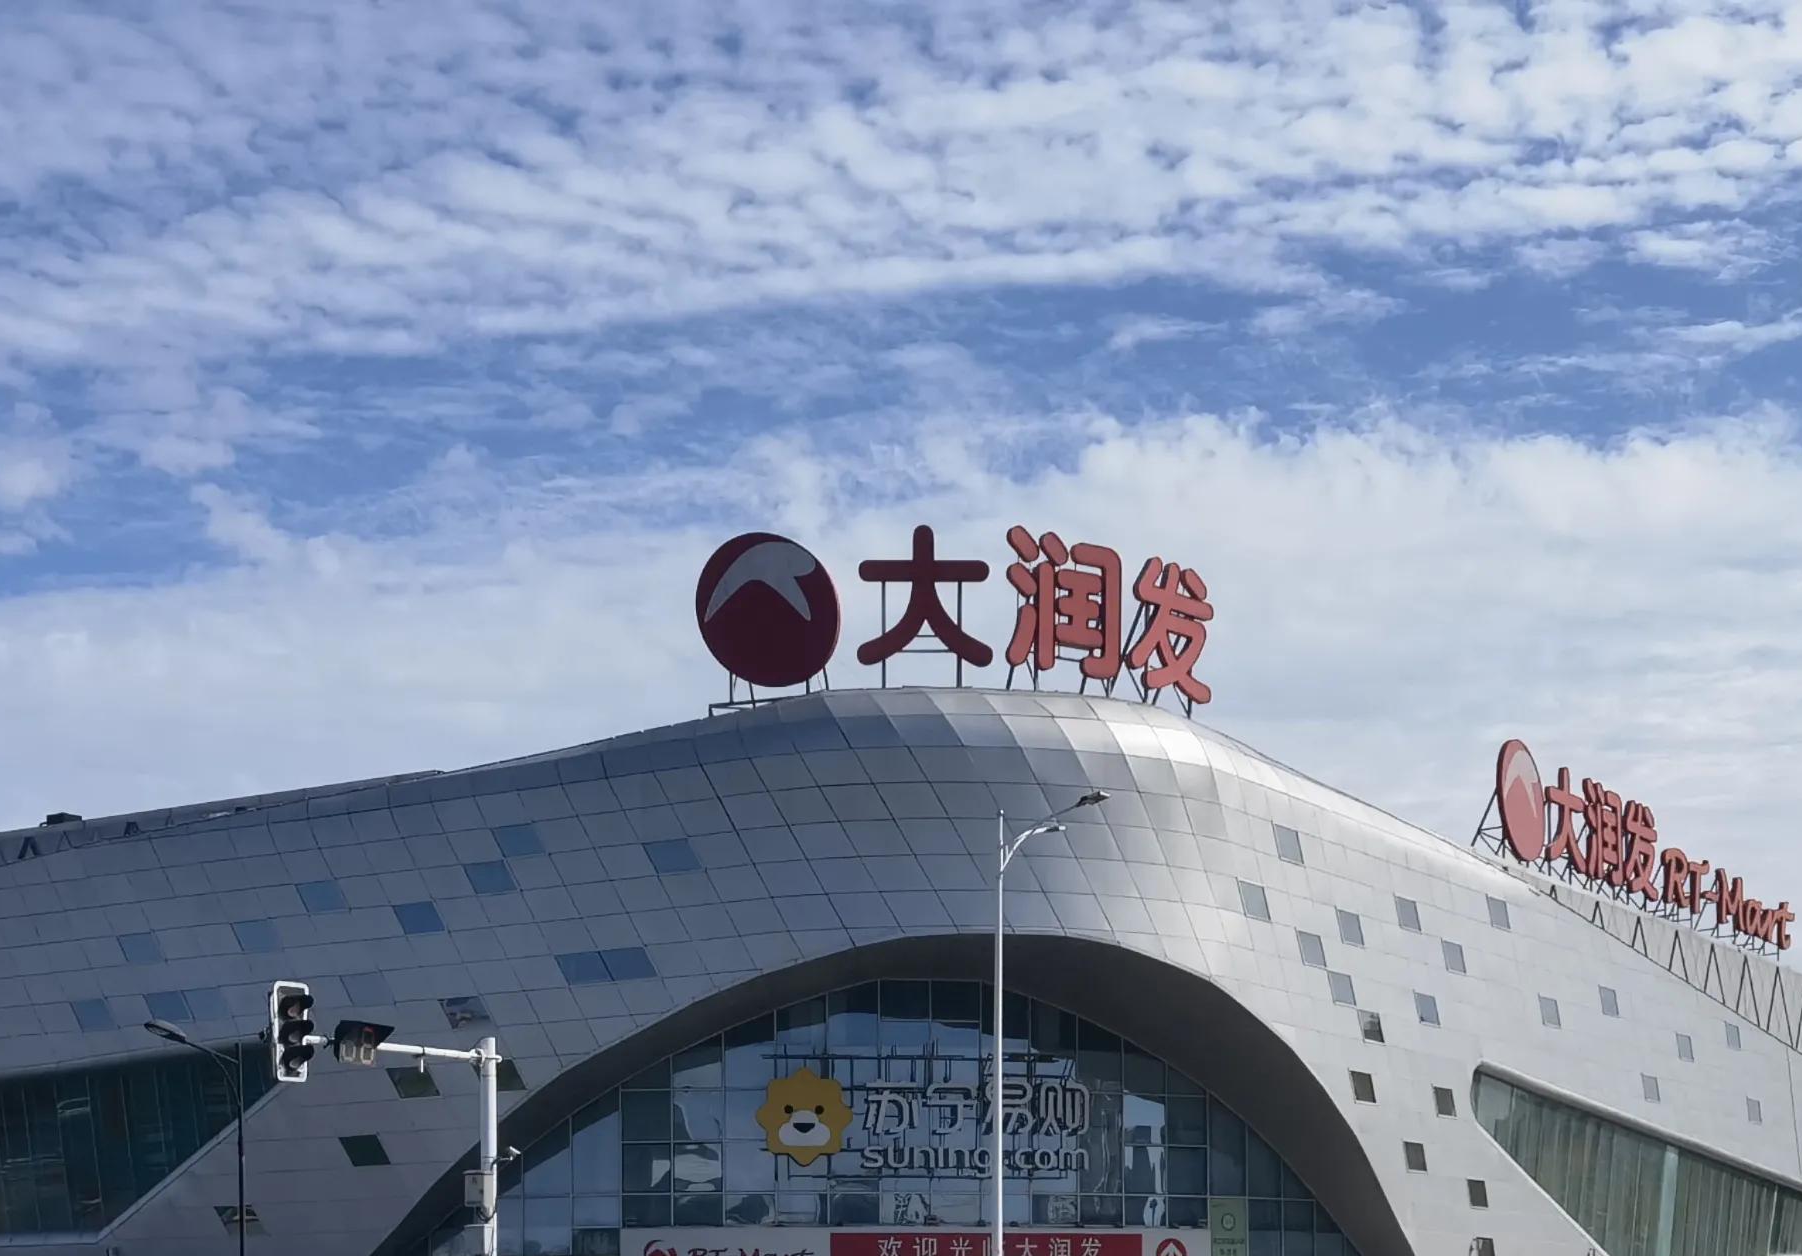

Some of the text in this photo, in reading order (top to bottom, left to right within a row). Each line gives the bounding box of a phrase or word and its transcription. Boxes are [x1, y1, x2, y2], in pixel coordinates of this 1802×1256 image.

[857, 524, 1214, 705] 大润发
[1544, 766, 1796, 950] 大润发 RT-Mart
